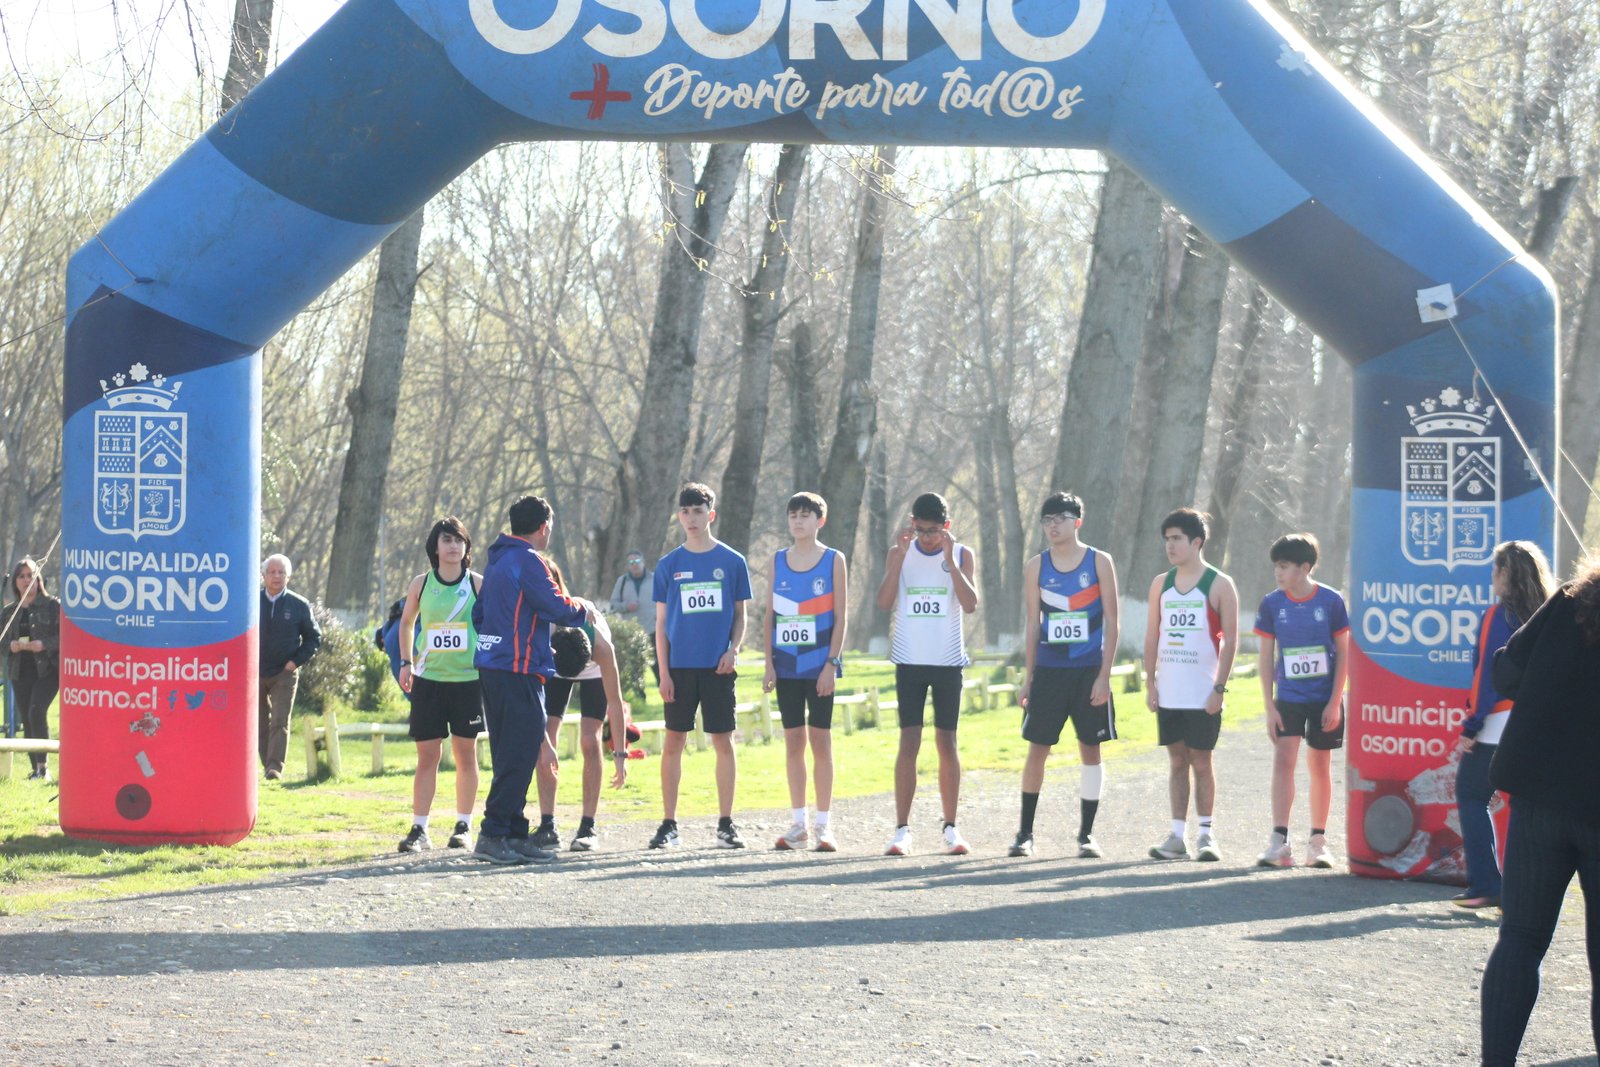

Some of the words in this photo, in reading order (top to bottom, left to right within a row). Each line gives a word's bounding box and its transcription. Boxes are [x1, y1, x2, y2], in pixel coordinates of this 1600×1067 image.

[643, 63, 810, 120] Deporte
[815, 72, 928, 120] para
[938, 65, 1085, 120] tod@s
[141, 522, 169, 530] AMORE
[65, 548, 230, 573] MUNICIPALIDAD
[64, 572, 229, 612] OSORNO
[1362, 581, 1501, 605] MUNICIPALI
[688, 595, 715, 609] 004
[913, 601, 940, 614] 003
[115, 614, 155, 627] CHILE
[1170, 613, 1196, 626] 002
[1362, 606, 1485, 646] OSOR
[782, 629, 809, 643] 006
[1054, 625, 1082, 639] 005
[433, 635, 461, 648] 050
[1428, 650, 1470, 662] CHILE
[63, 654, 229, 685] municipalidad
[1291, 661, 1319, 675] 007
[63, 686, 158, 710] osorno.cl
[1361, 700, 1469, 731] municip
